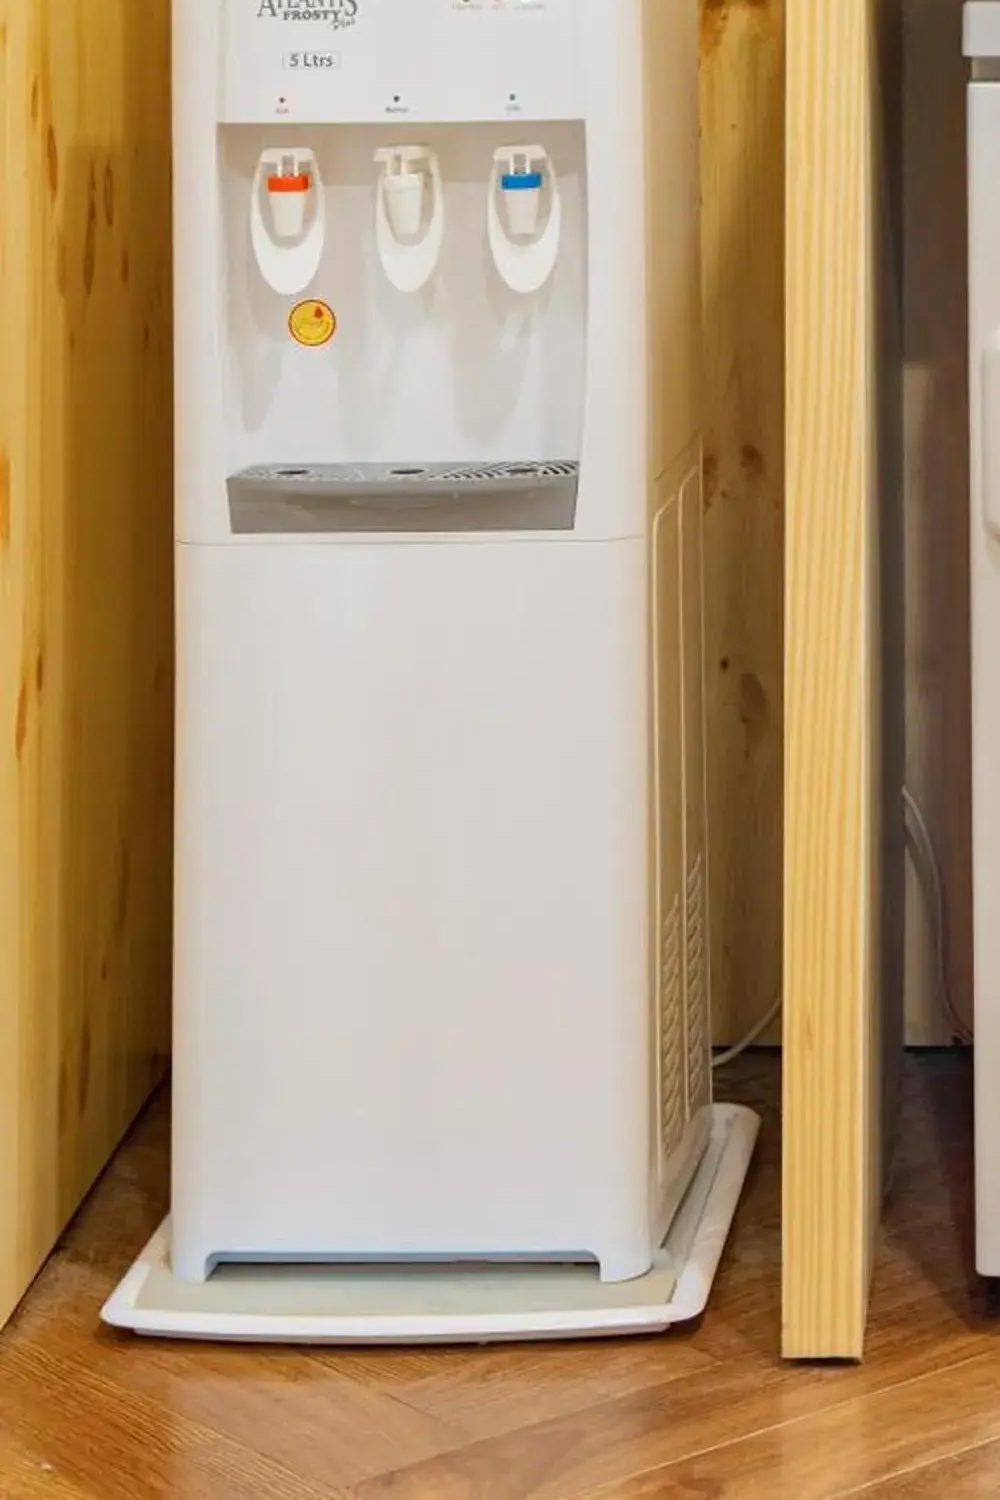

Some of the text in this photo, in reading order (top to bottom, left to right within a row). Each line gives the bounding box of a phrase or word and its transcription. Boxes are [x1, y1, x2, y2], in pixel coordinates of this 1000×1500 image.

[283, 9, 341, 21] FROSTY
[289, 51, 334, 67] 5 Ltrs
